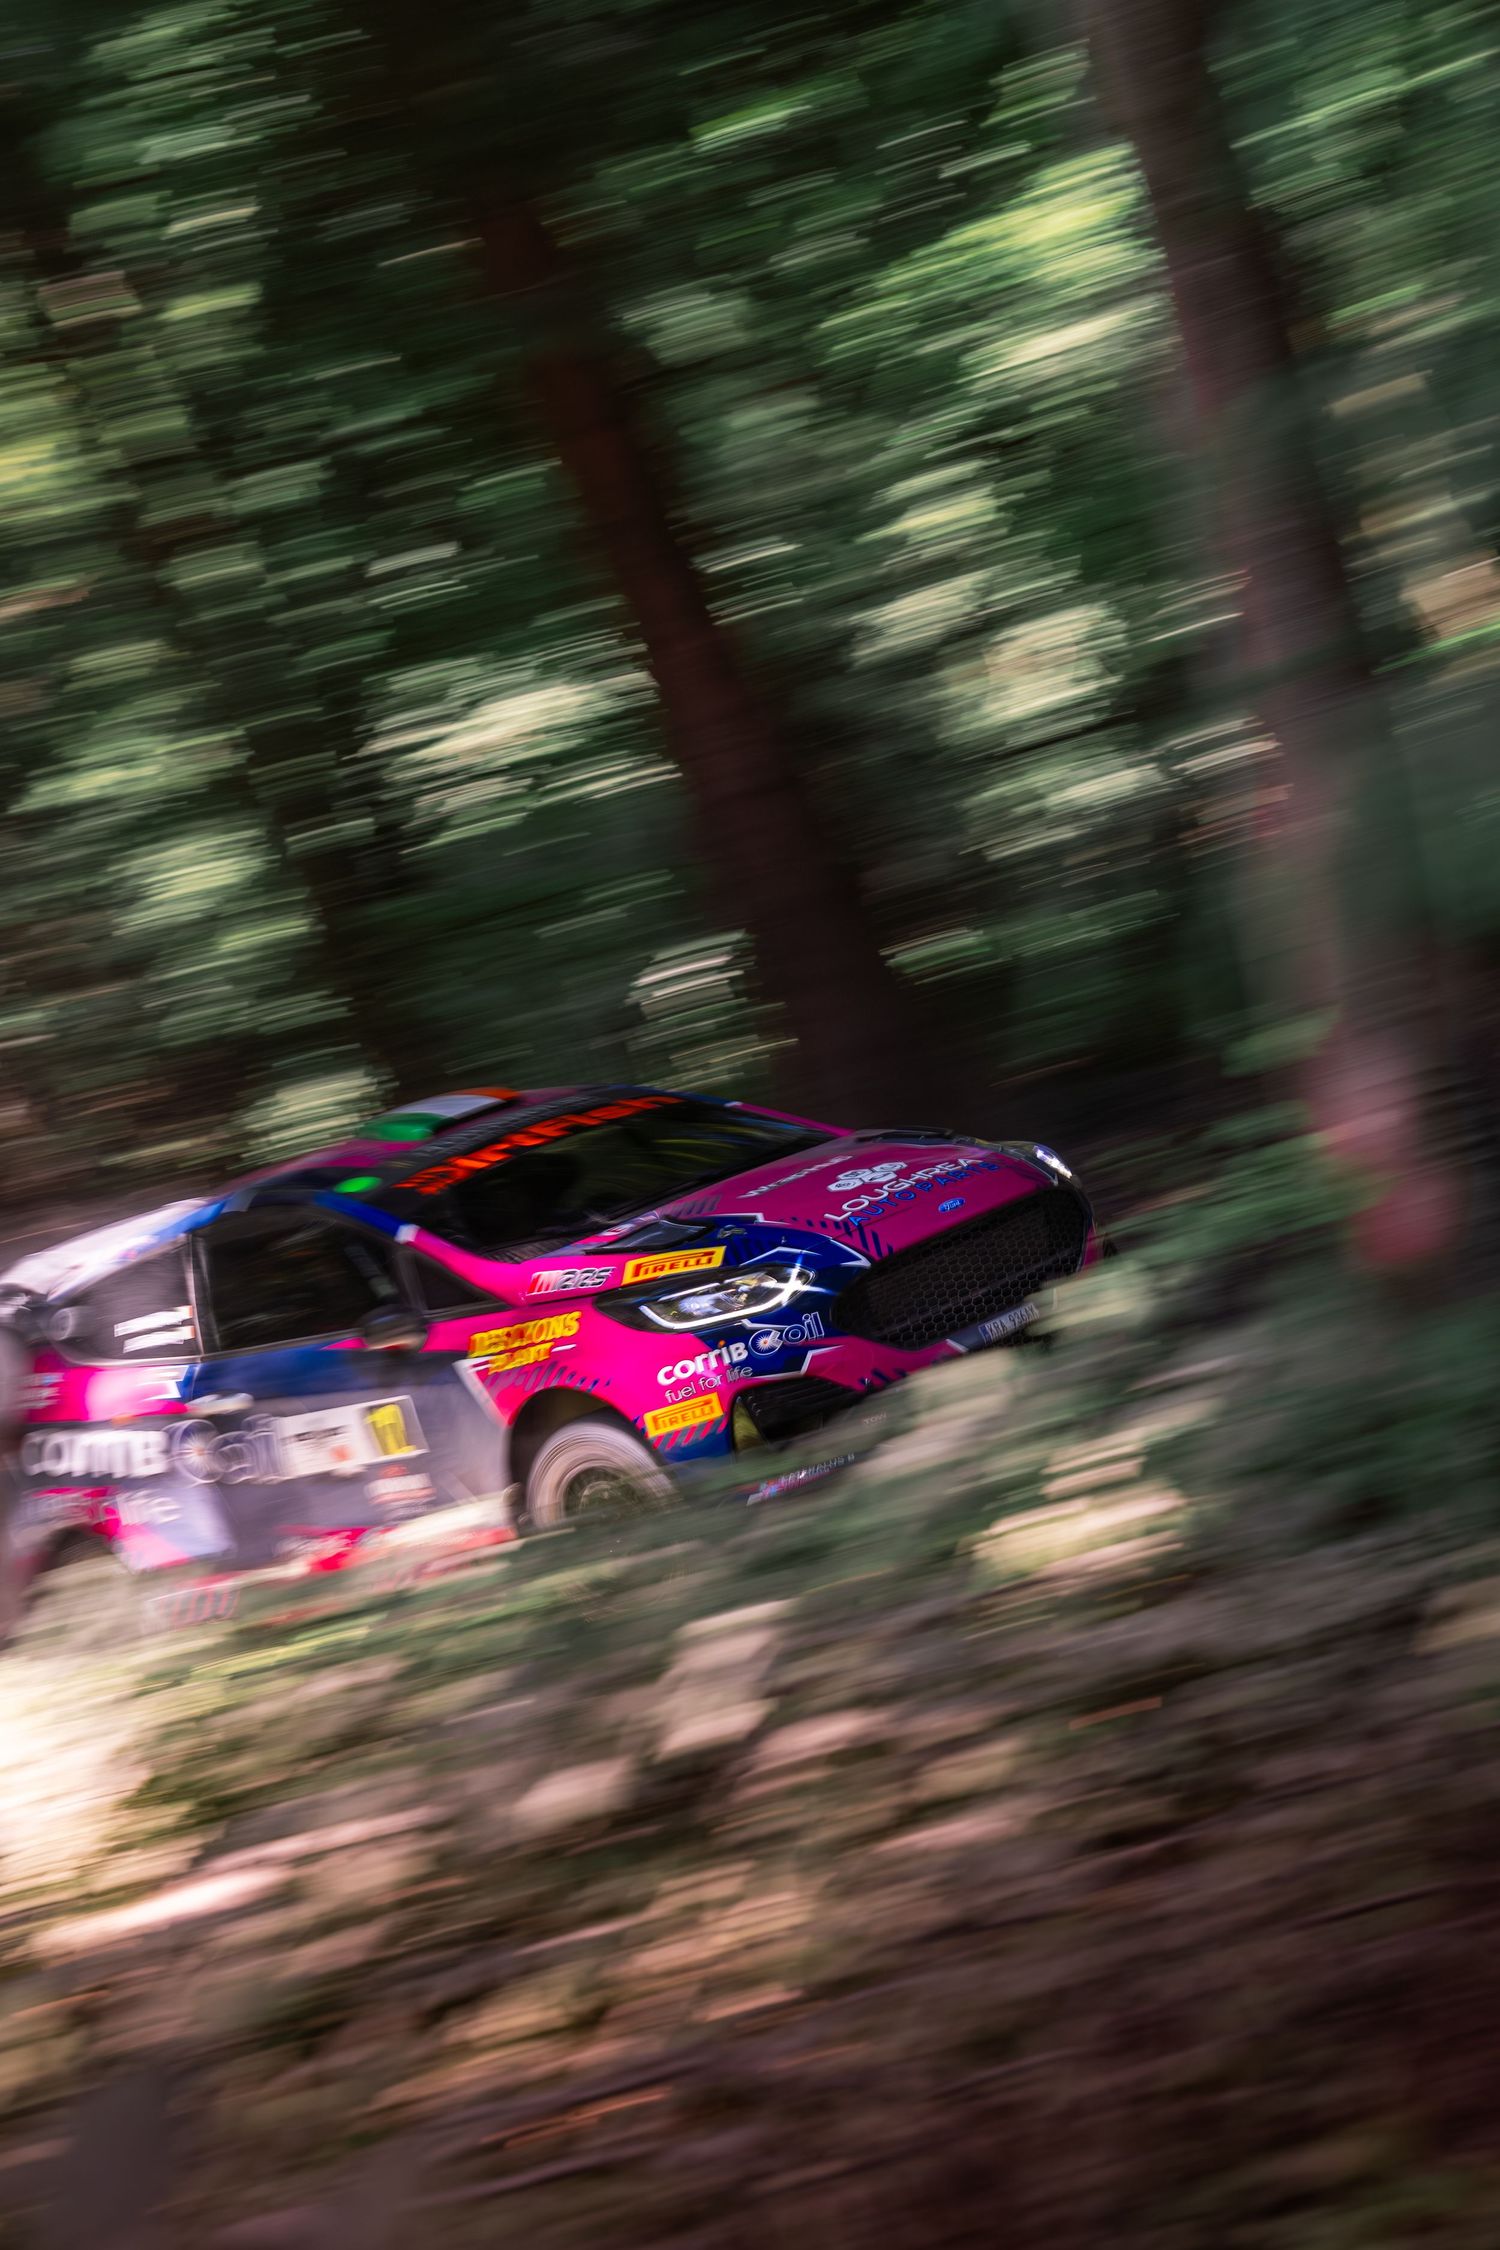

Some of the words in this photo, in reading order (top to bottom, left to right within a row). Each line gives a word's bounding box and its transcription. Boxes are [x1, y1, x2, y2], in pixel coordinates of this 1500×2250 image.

[824, 1158, 982, 1221] LOUGHREA
[633, 1250, 716, 1278] PIRELLI
[783, 1311, 825, 1344] oil
[665, 1382, 697, 1404] fuel
[700, 1373, 723, 1391] for
[726, 1366, 753, 1384] life
[653, 1398, 716, 1431] PIRELLI
